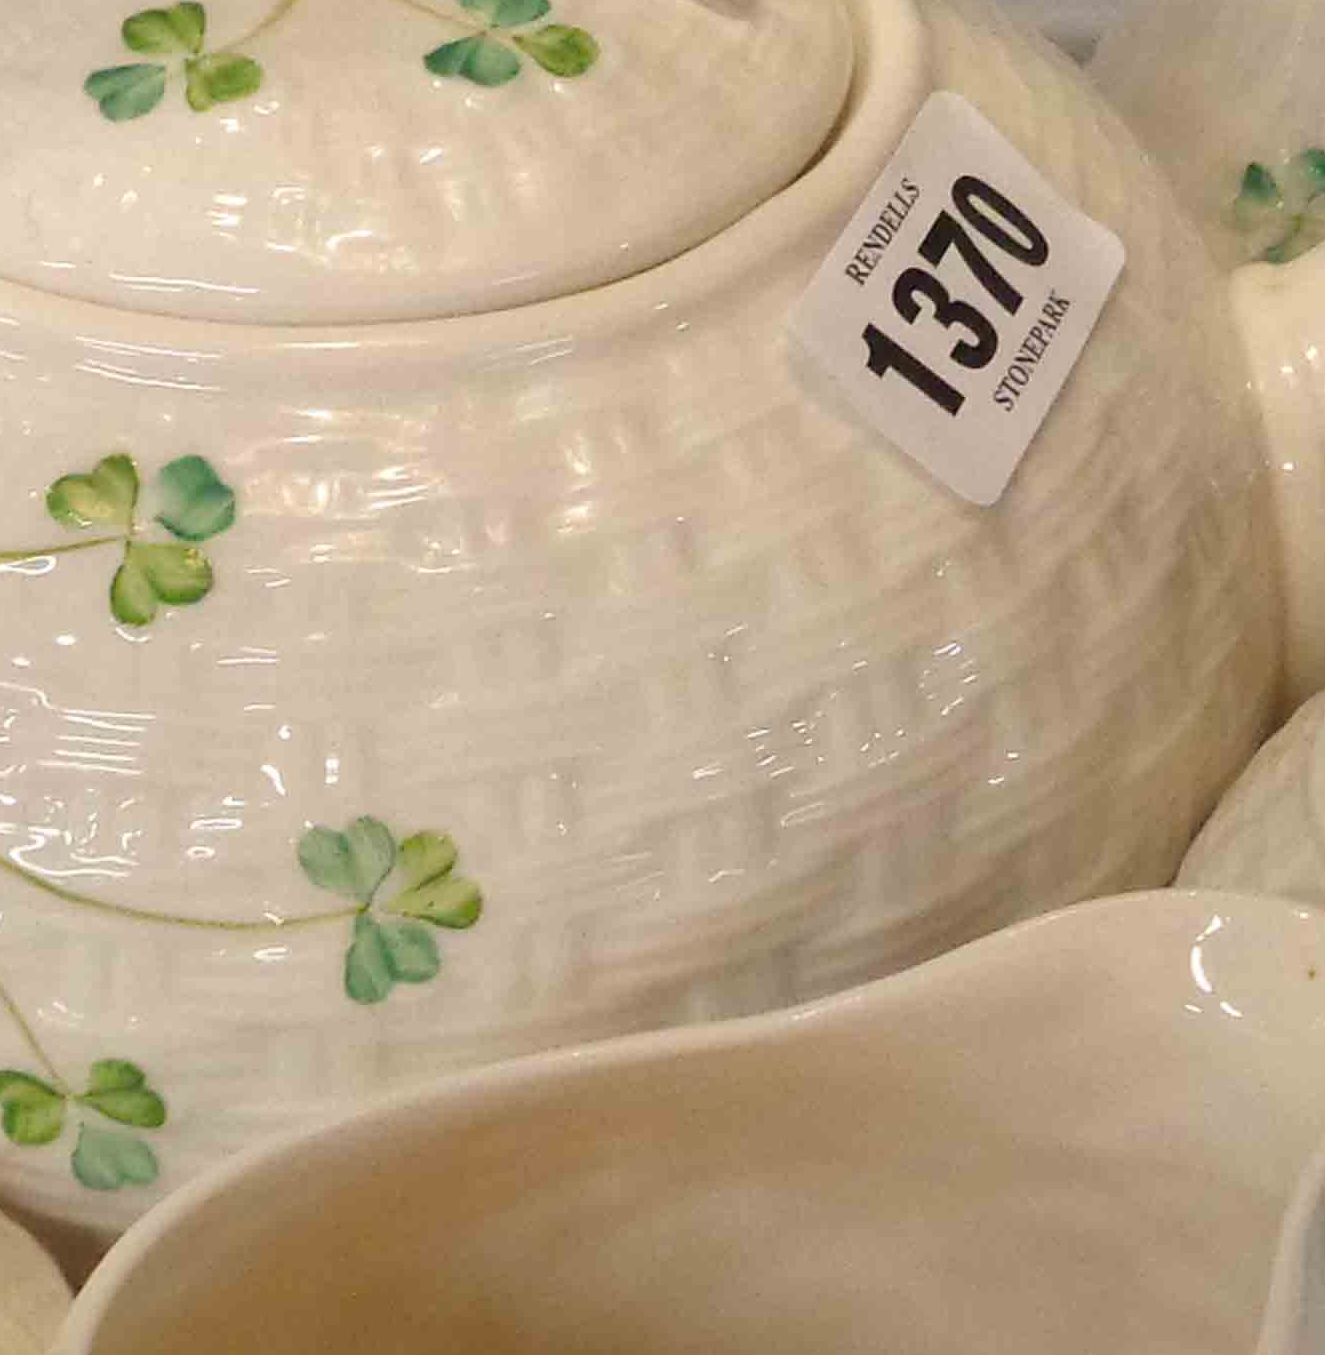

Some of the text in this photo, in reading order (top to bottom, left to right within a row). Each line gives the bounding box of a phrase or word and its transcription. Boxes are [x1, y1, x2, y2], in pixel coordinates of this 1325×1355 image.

[845, 177, 922, 286] RENDELLS
[859, 175, 1049, 417] 1370
[993, 292, 1072, 413] STONEPARK
